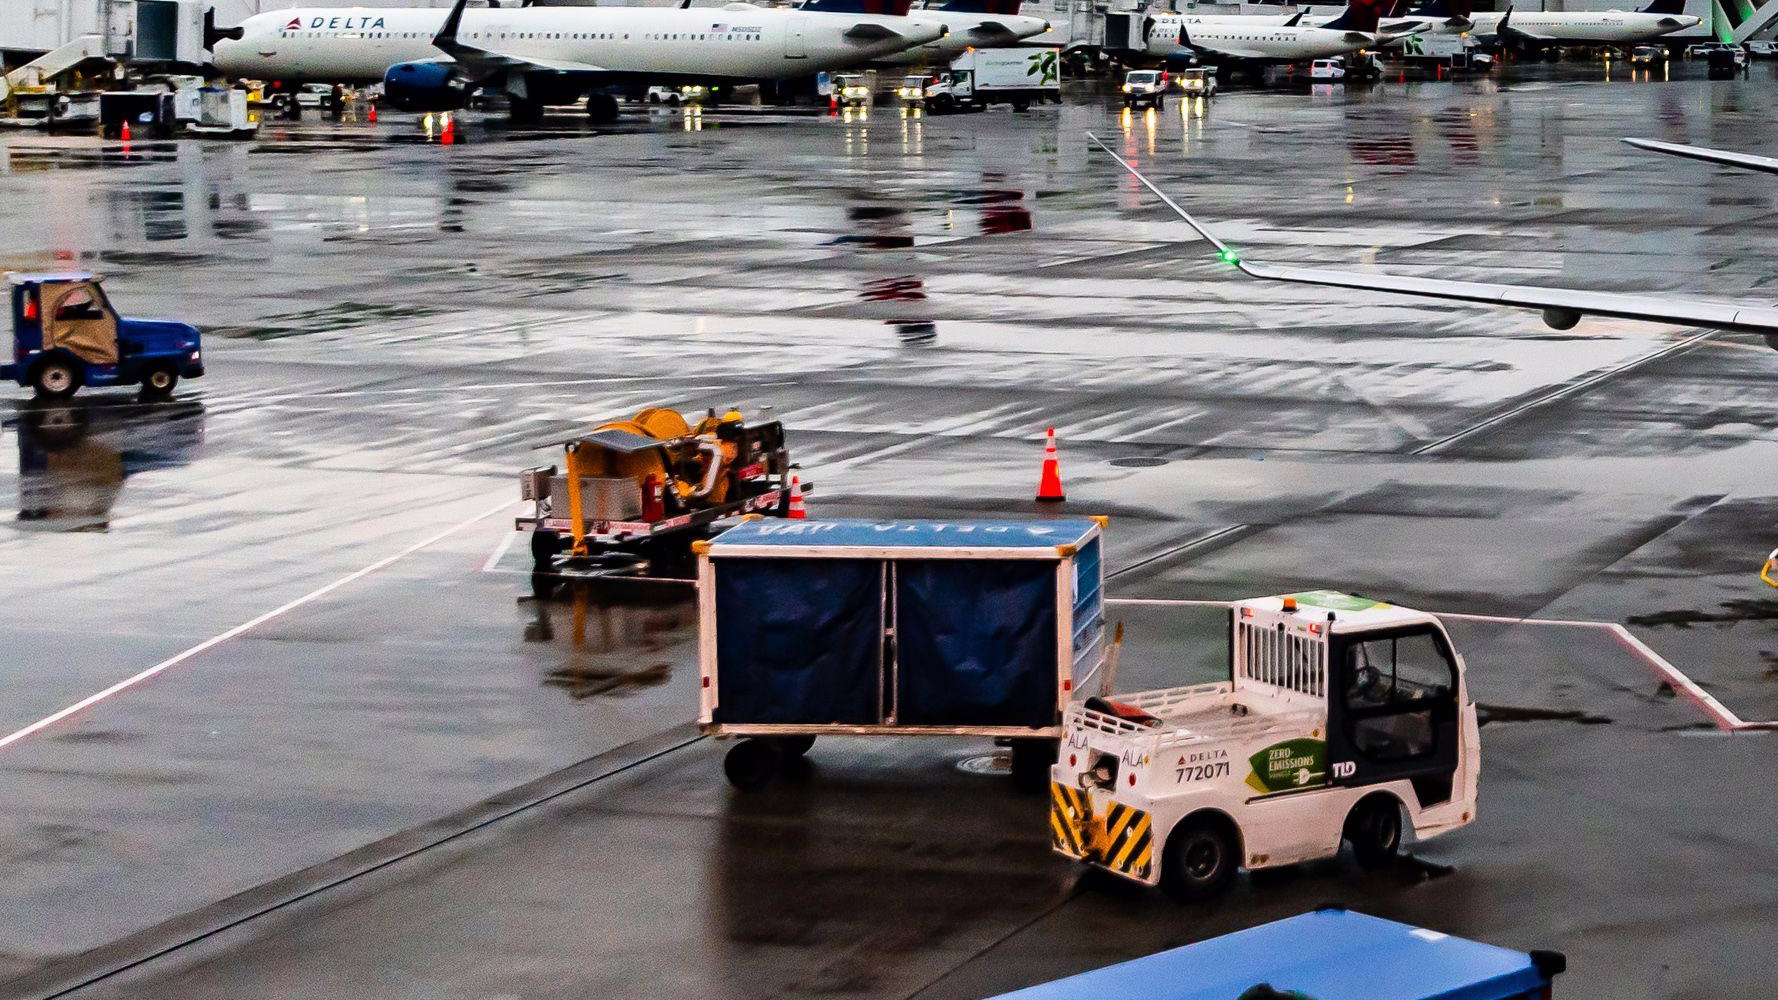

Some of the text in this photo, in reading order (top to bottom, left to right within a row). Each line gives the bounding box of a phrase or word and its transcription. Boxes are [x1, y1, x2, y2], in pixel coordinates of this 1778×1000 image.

[310, 17, 385, 29] DELTA
[1189, 750, 1229, 763] DELTA
[1269, 755, 1314, 771] EMISSIONS
[1176, 761, 1230, 784] 772071
[1333, 761, 1356, 778] TLD
